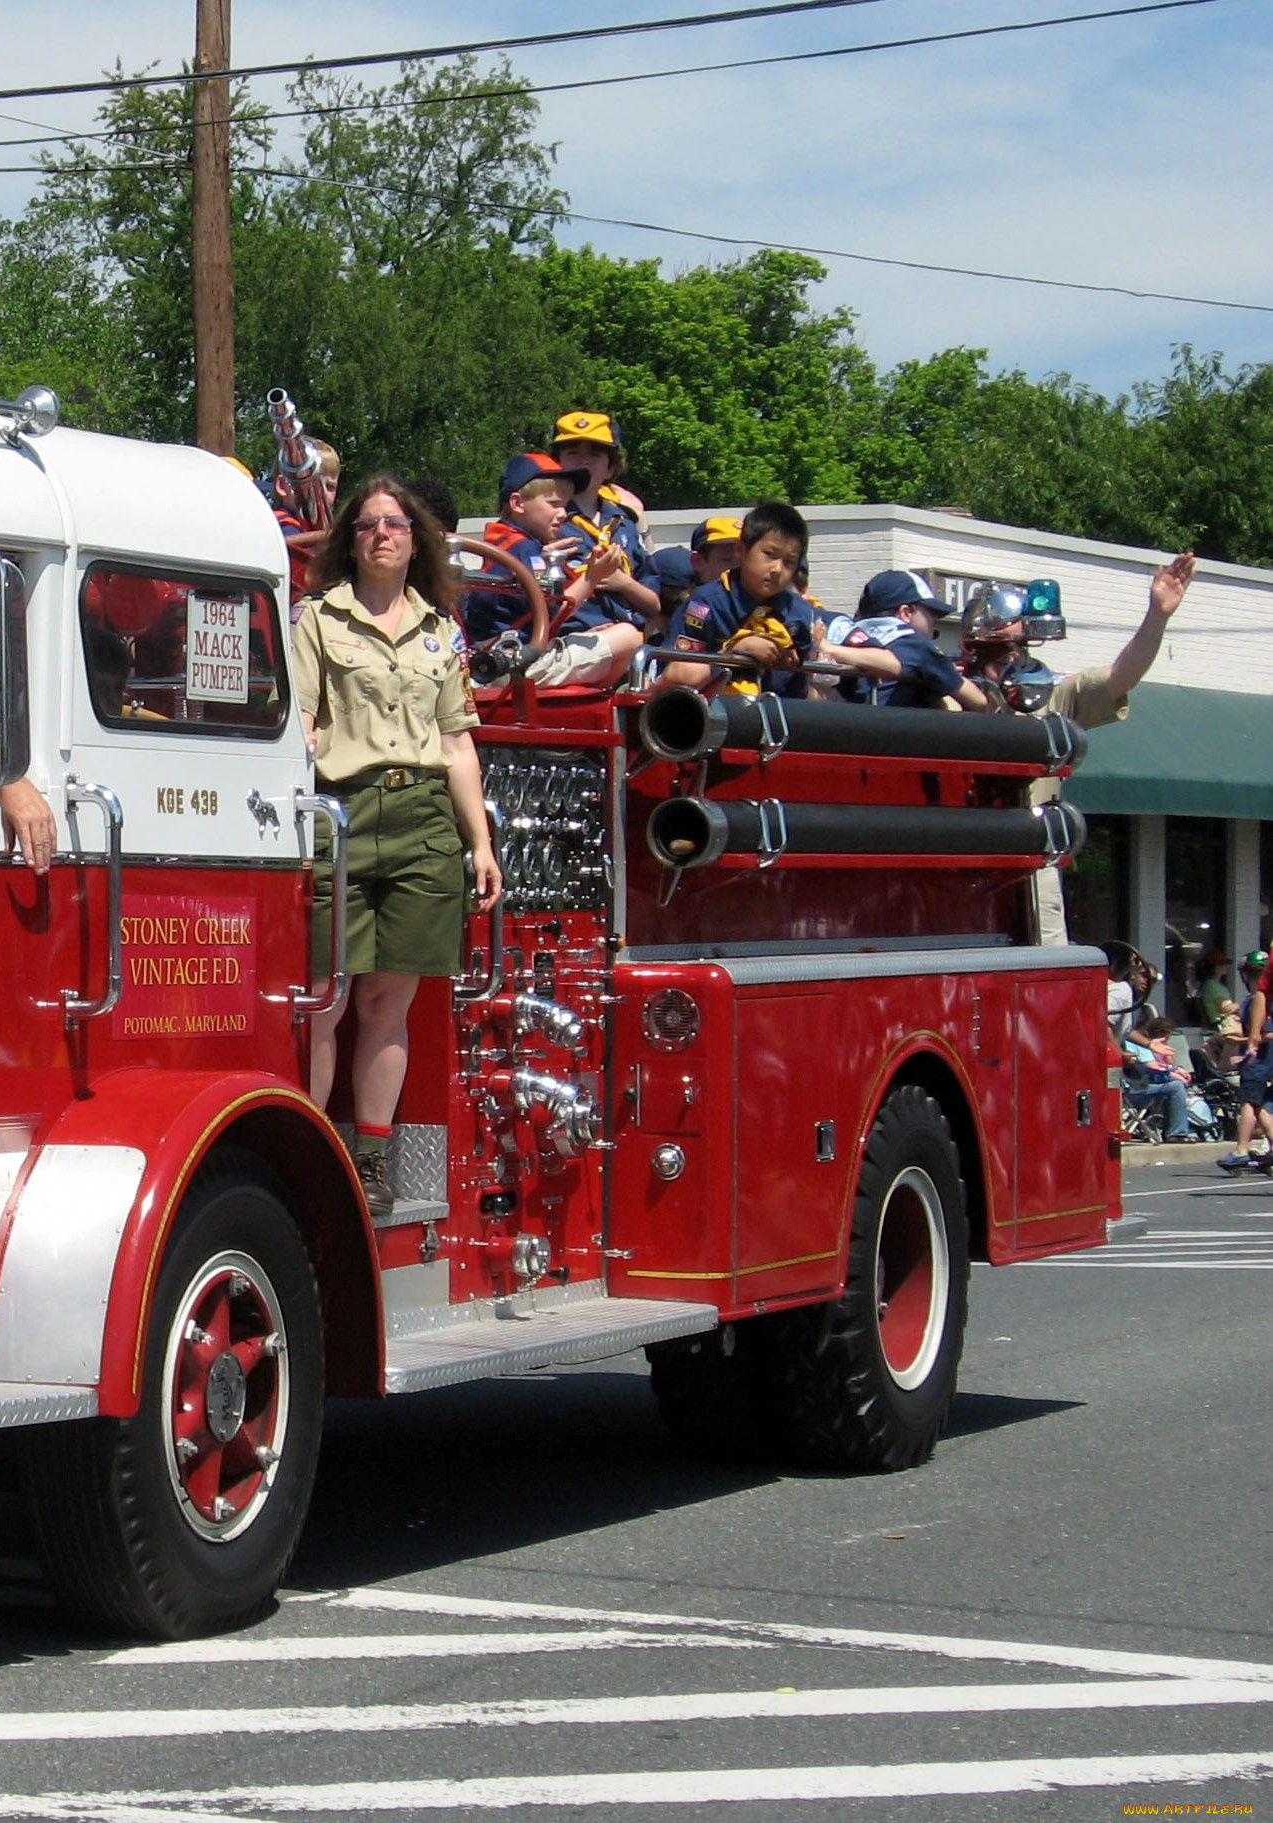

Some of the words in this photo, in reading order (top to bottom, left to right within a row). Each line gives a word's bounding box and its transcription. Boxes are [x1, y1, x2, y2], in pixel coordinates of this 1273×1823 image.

[202, 602, 236, 627] 1964
[194, 630, 243, 660] MACK
[191, 662, 244, 692] PUMPER
[191, 789, 218, 815] 438
[120, 917, 190, 945] STONEY
[194, 918, 252, 945] CREEK
[130, 957, 208, 986] VINTAGE
[212, 957, 242, 986] F.D.
[185, 1014, 247, 1033] MARYLAND
